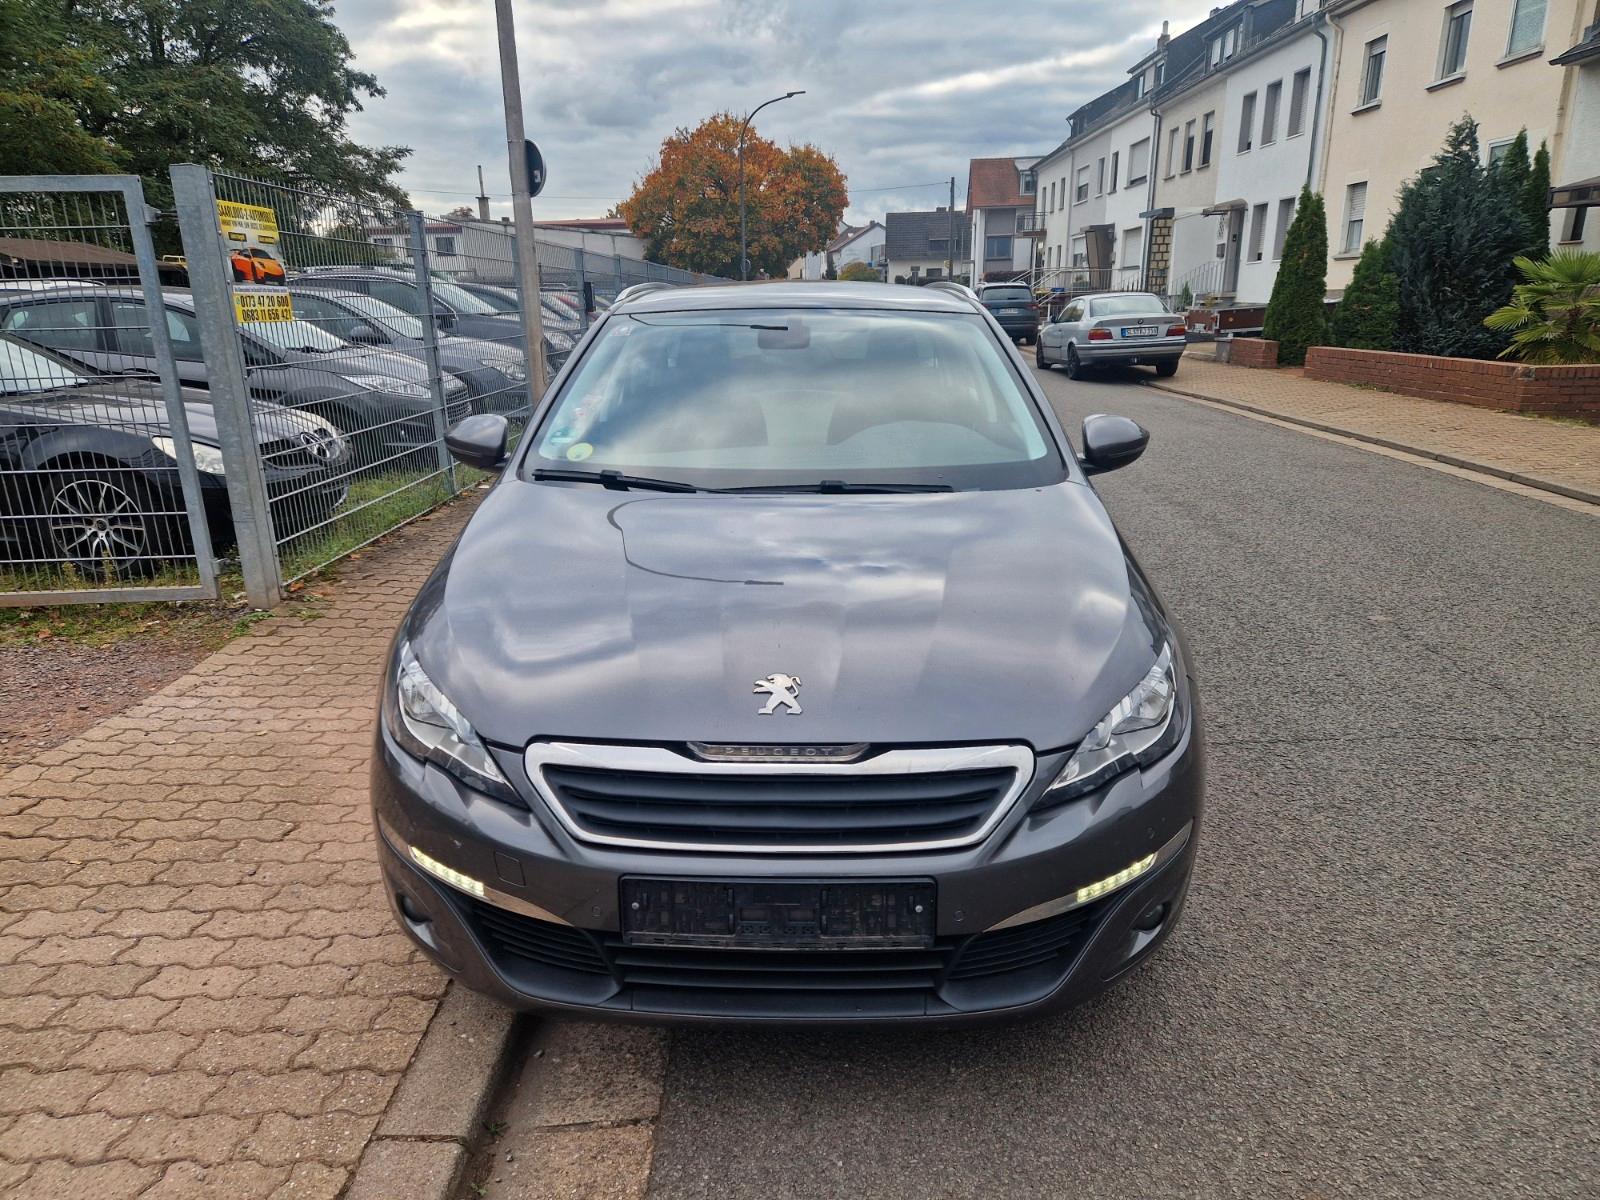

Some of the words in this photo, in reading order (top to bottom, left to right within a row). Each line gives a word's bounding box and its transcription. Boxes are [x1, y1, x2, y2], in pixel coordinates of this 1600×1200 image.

[240, 296, 256, 307] 0173
[257, 296, 265, 307] 47
[266, 296, 276, 307] 20
[276, 296, 290, 307] 600
[242, 309, 260, 321] 0683
[260, 309, 267, 320] 11
[267, 309, 280, 320] 656
[280, 309, 292, 320] 421
[725, 747, 833, 756] PEUGEOT
